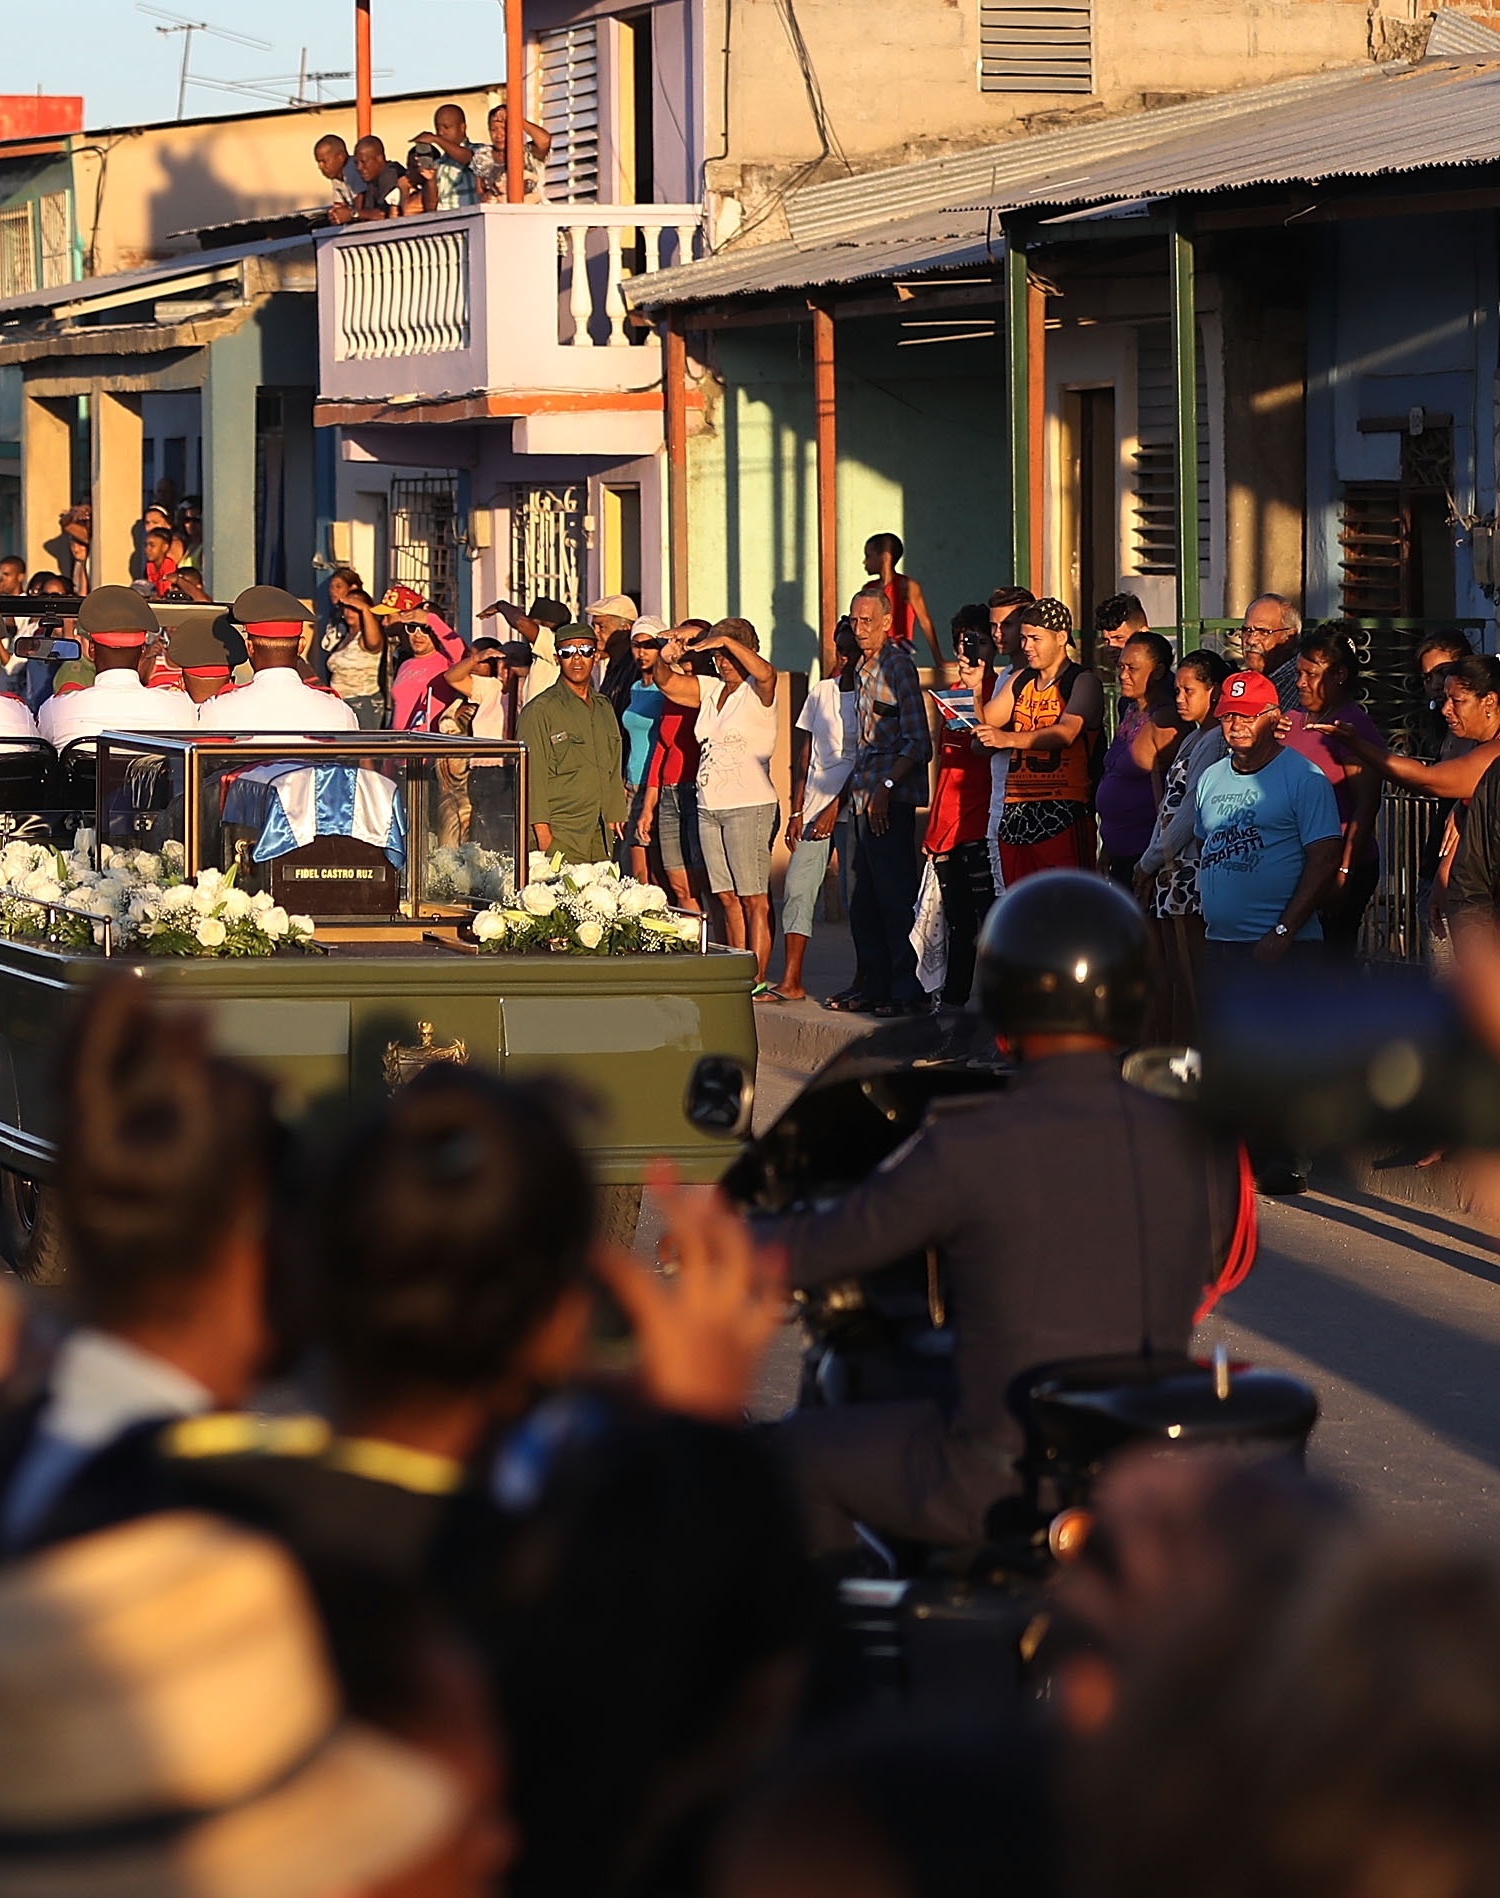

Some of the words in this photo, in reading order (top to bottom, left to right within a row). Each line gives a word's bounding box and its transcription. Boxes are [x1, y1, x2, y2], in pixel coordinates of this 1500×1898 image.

[1231, 681, 1245, 697] S
[1226, 826, 1259, 844] MAKE
[295, 868, 319, 879] FIDEL
[321, 868, 355, 879] CASTRO
[356, 868, 373, 879] RUZ
